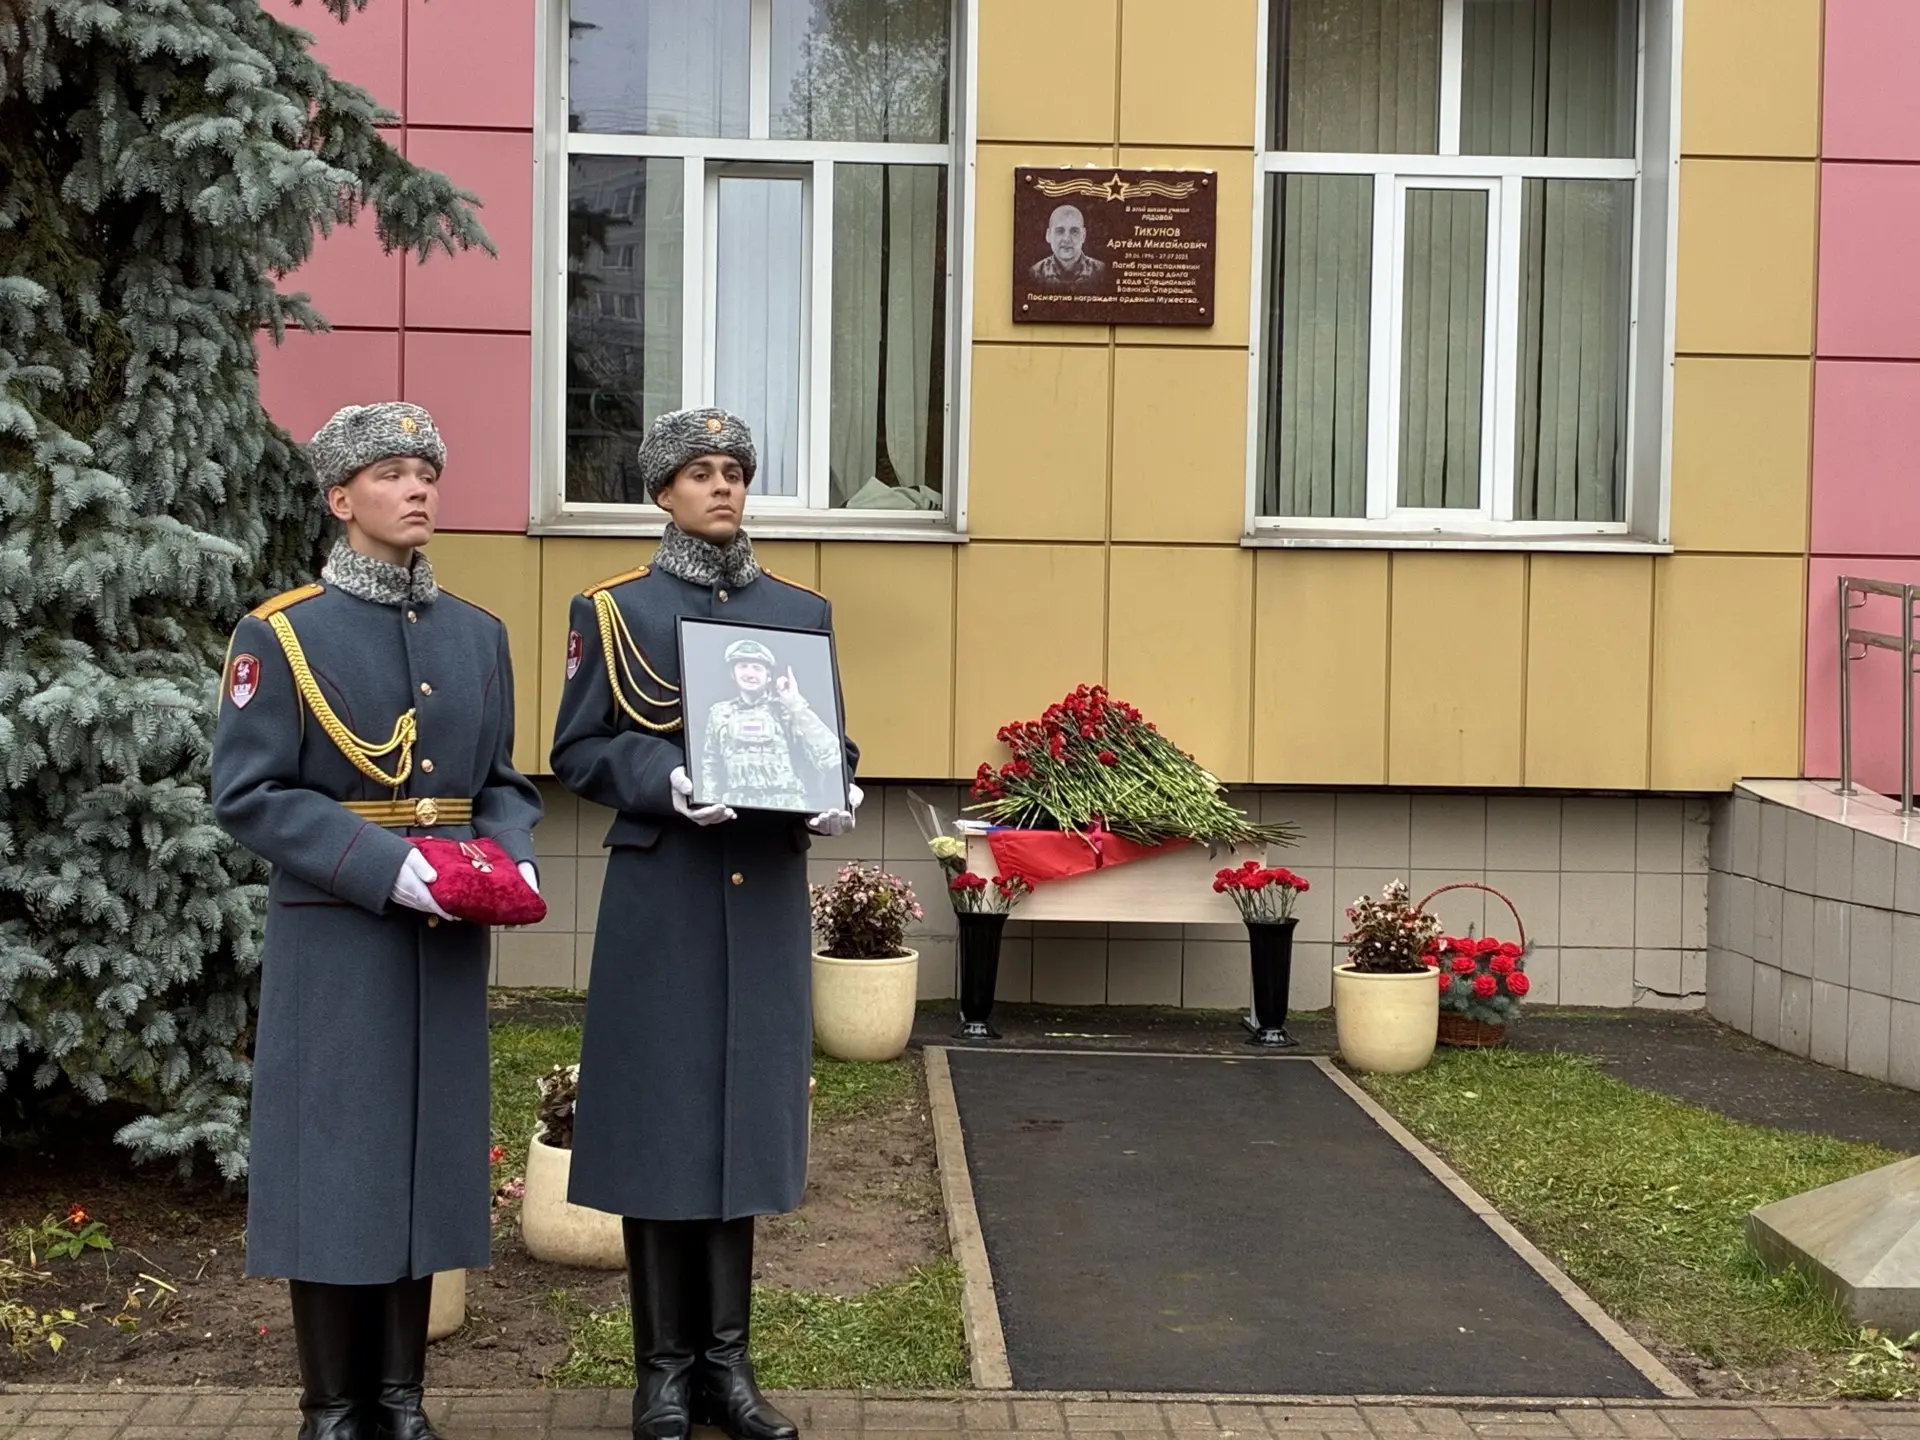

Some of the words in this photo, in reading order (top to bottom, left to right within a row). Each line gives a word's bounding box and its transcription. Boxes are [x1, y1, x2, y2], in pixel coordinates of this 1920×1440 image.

[1107, 239, 1141, 249] Артём
[1144, 240, 1207, 249] Михайлович
[1027, 293, 1072, 302] Посмертно
